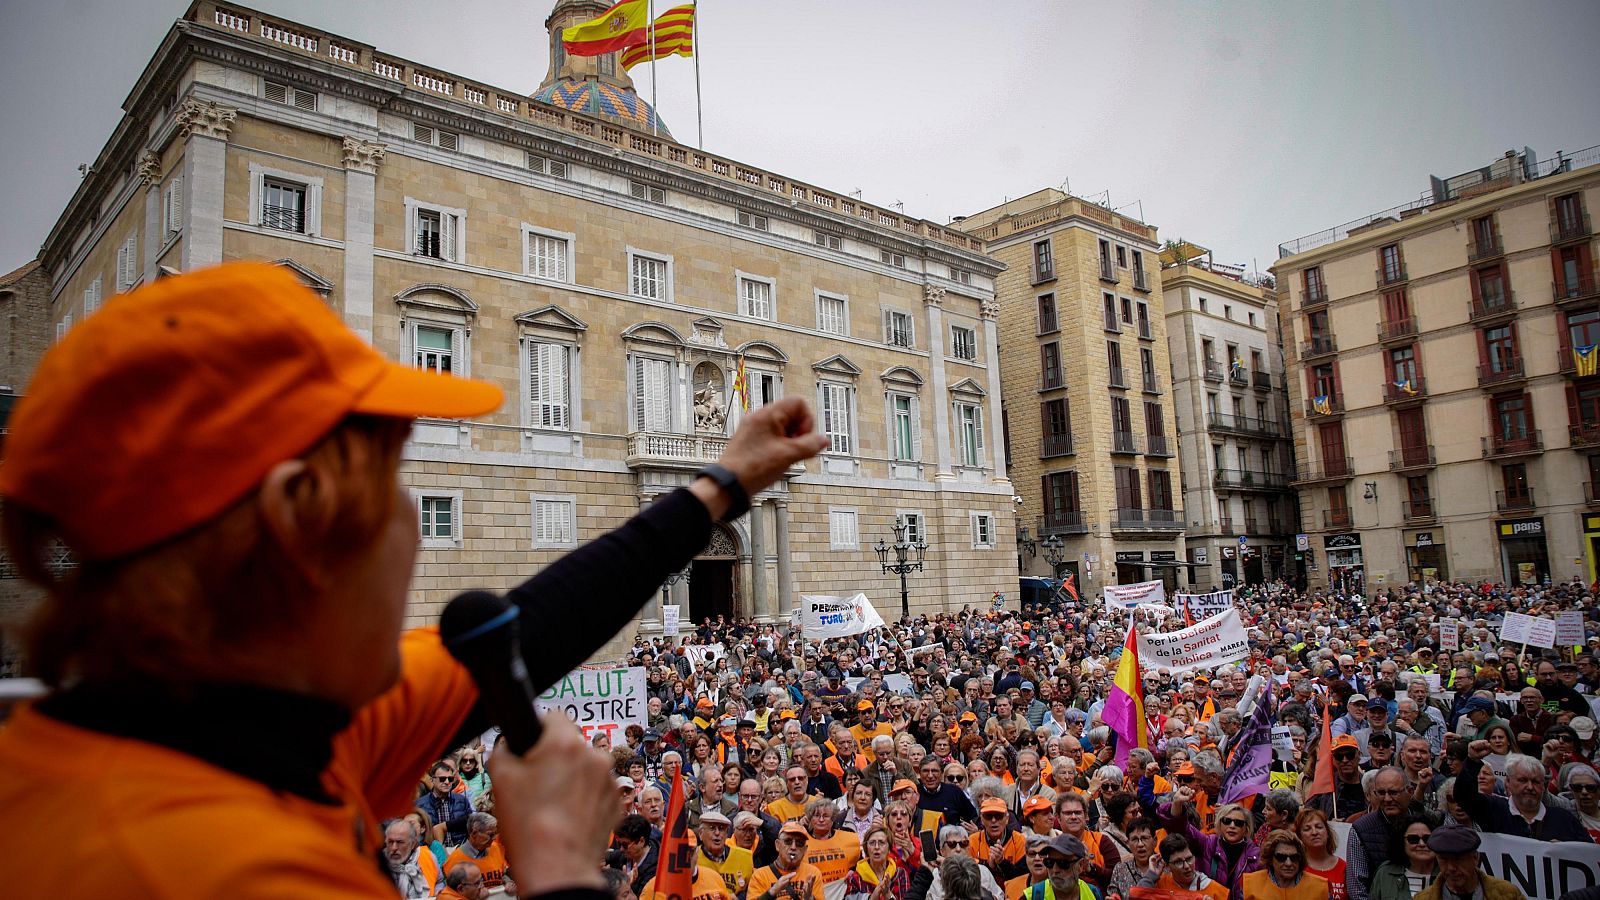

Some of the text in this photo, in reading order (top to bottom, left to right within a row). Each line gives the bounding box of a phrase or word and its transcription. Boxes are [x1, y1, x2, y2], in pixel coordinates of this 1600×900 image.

[1513, 521, 1541, 534] pans
[1417, 540, 1432, 548] pans
[1177, 592, 1231, 606] LA SALUT
[1147, 620, 1222, 646] Per la Defensa
[1156, 633, 1221, 657] de la Sanitat
[1220, 641, 1245, 652] MAREA
[1172, 651, 1213, 667] Pública
[548, 698, 636, 722] OSTRE
